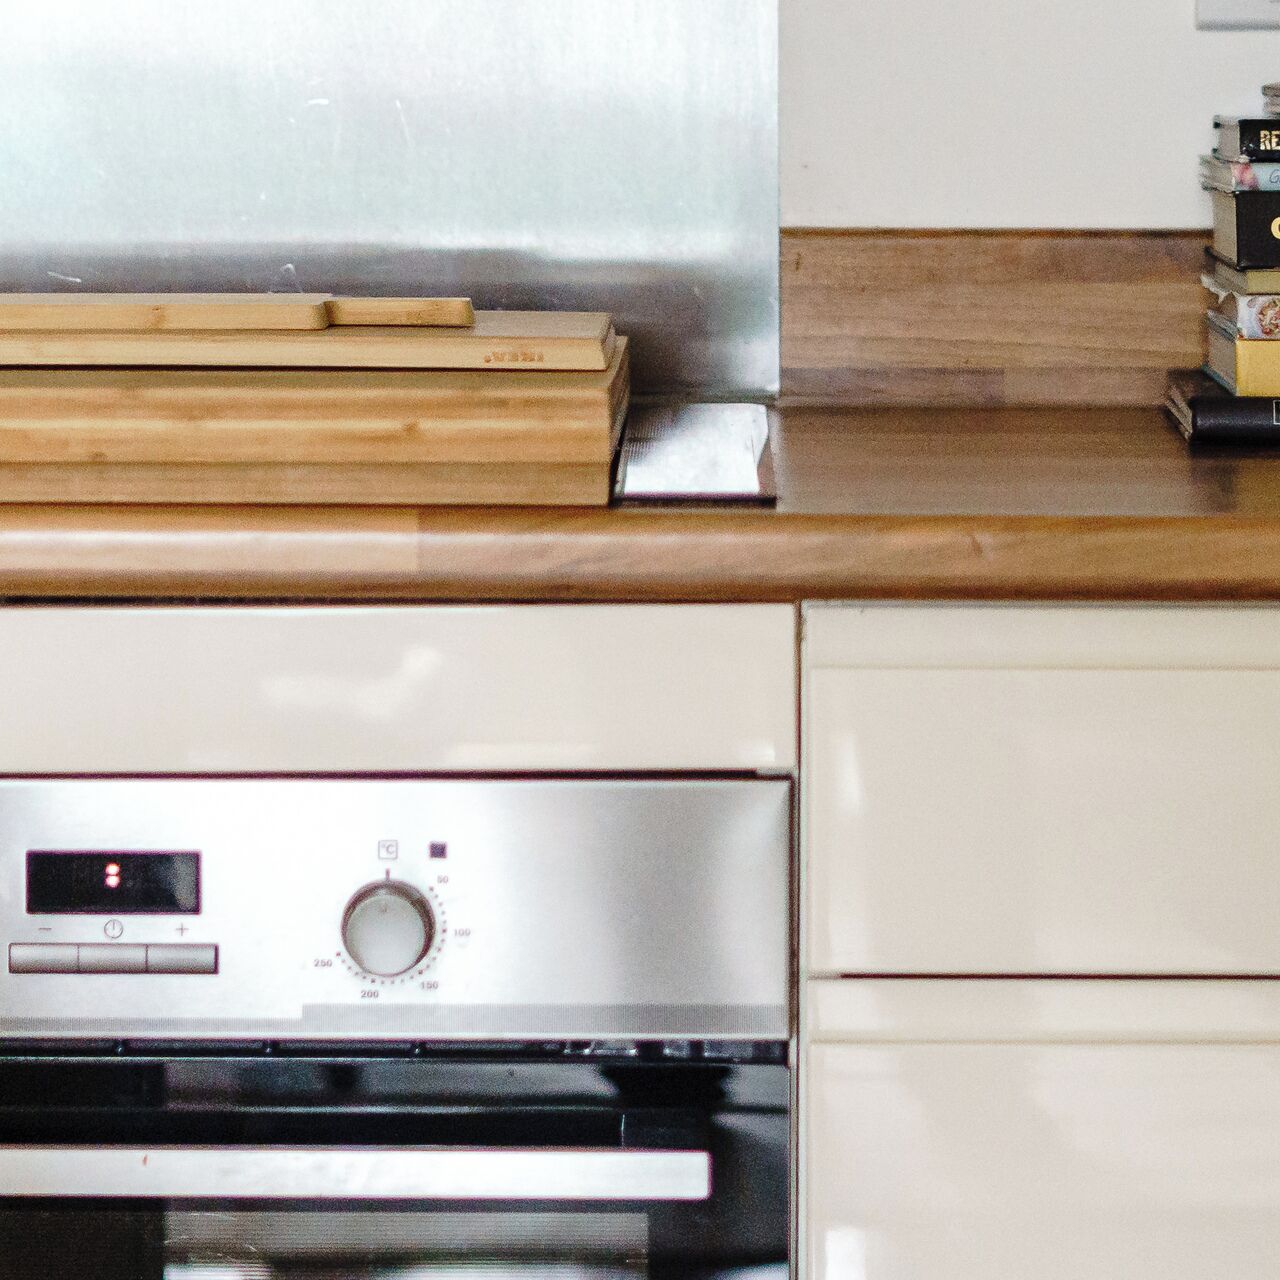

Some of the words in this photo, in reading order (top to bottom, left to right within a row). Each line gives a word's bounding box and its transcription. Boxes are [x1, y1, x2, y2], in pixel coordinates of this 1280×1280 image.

[437, 875, 449, 884] 50
[454, 928, 471, 937] 100
[313, 958, 333, 968] 250
[421, 980, 439, 990] 150
[361, 990, 380, 999] 200
